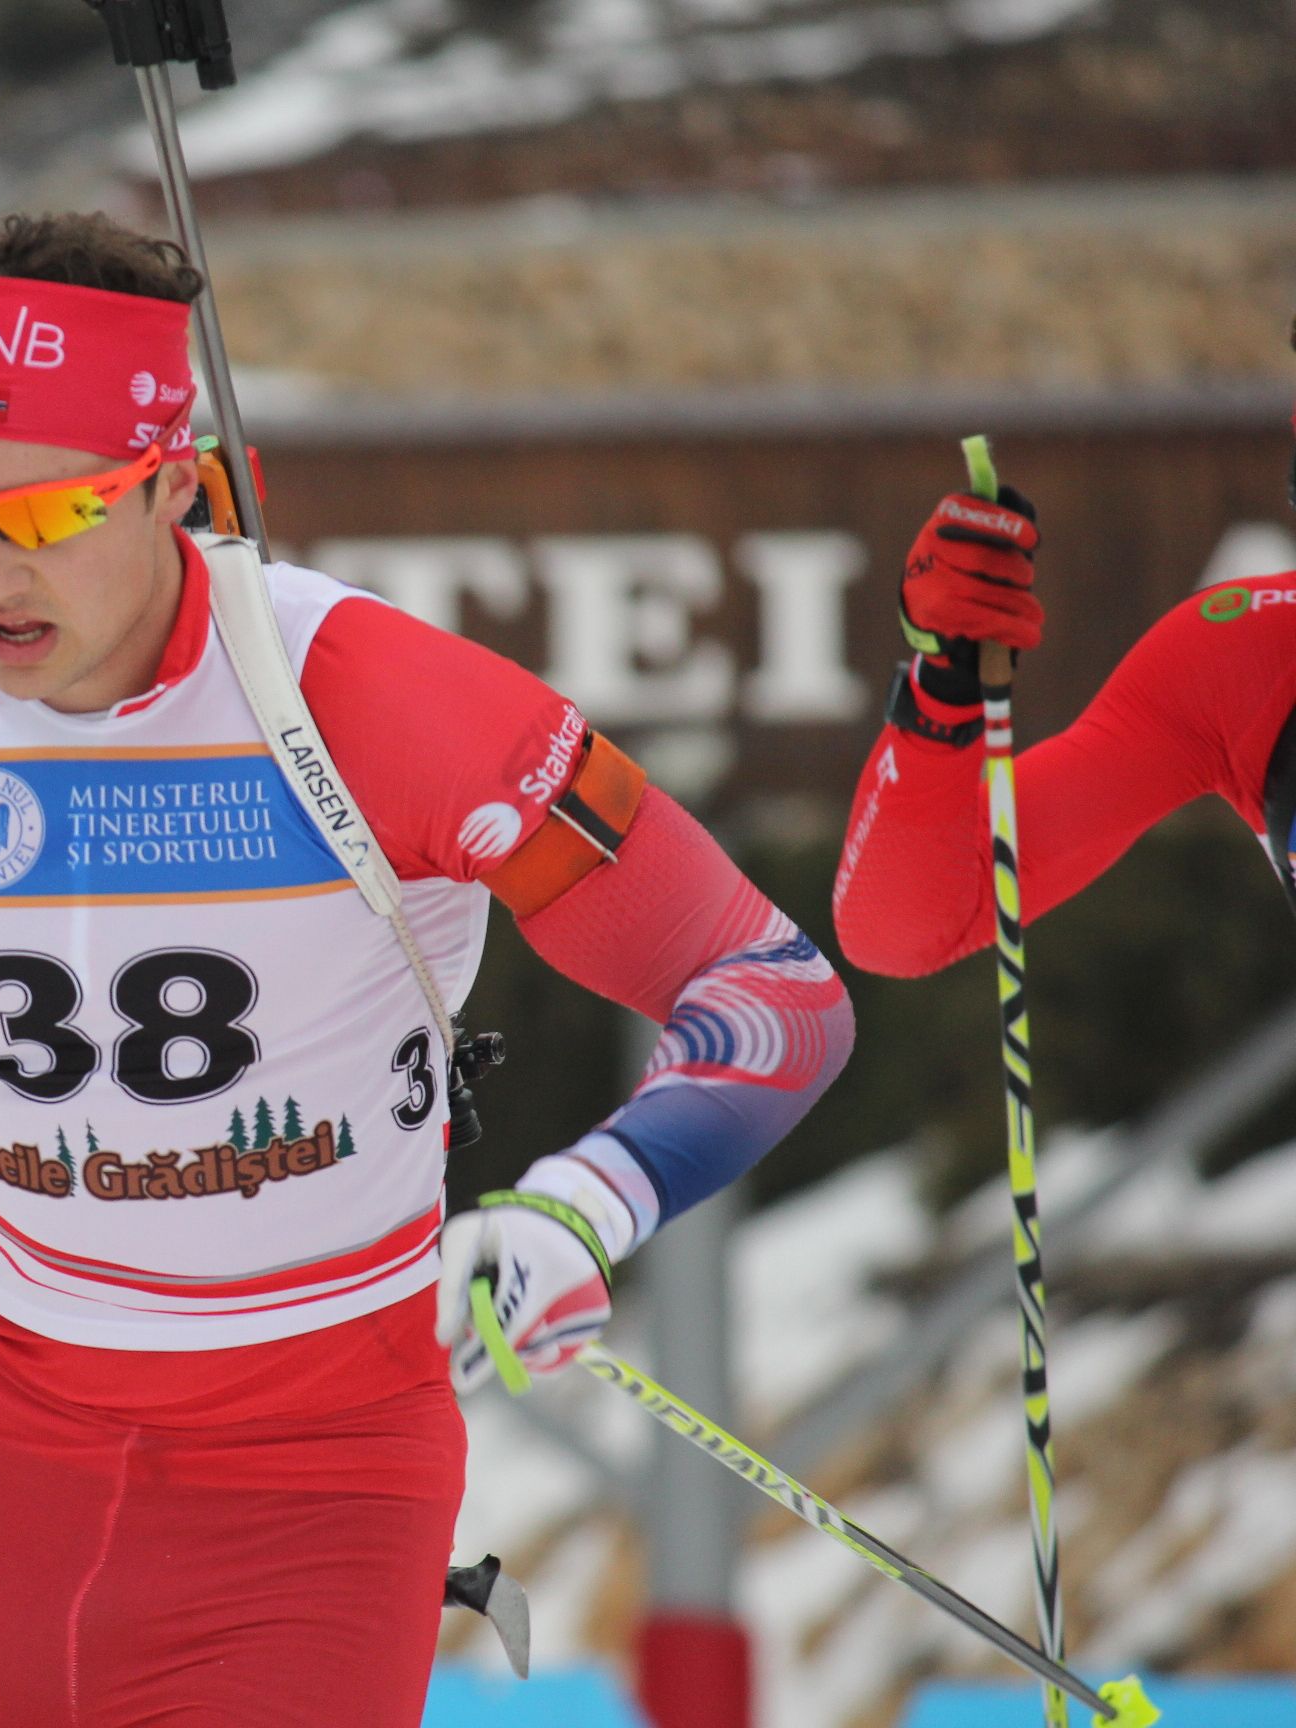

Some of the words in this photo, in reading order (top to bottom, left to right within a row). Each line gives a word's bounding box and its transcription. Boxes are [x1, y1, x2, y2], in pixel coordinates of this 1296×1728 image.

[280, 726, 355, 832] LARSEN
[68, 780, 271, 809] MINISTERUL
[67, 808, 273, 837] TINERETULUI
[103, 836, 278, 866] SPORTULUI
